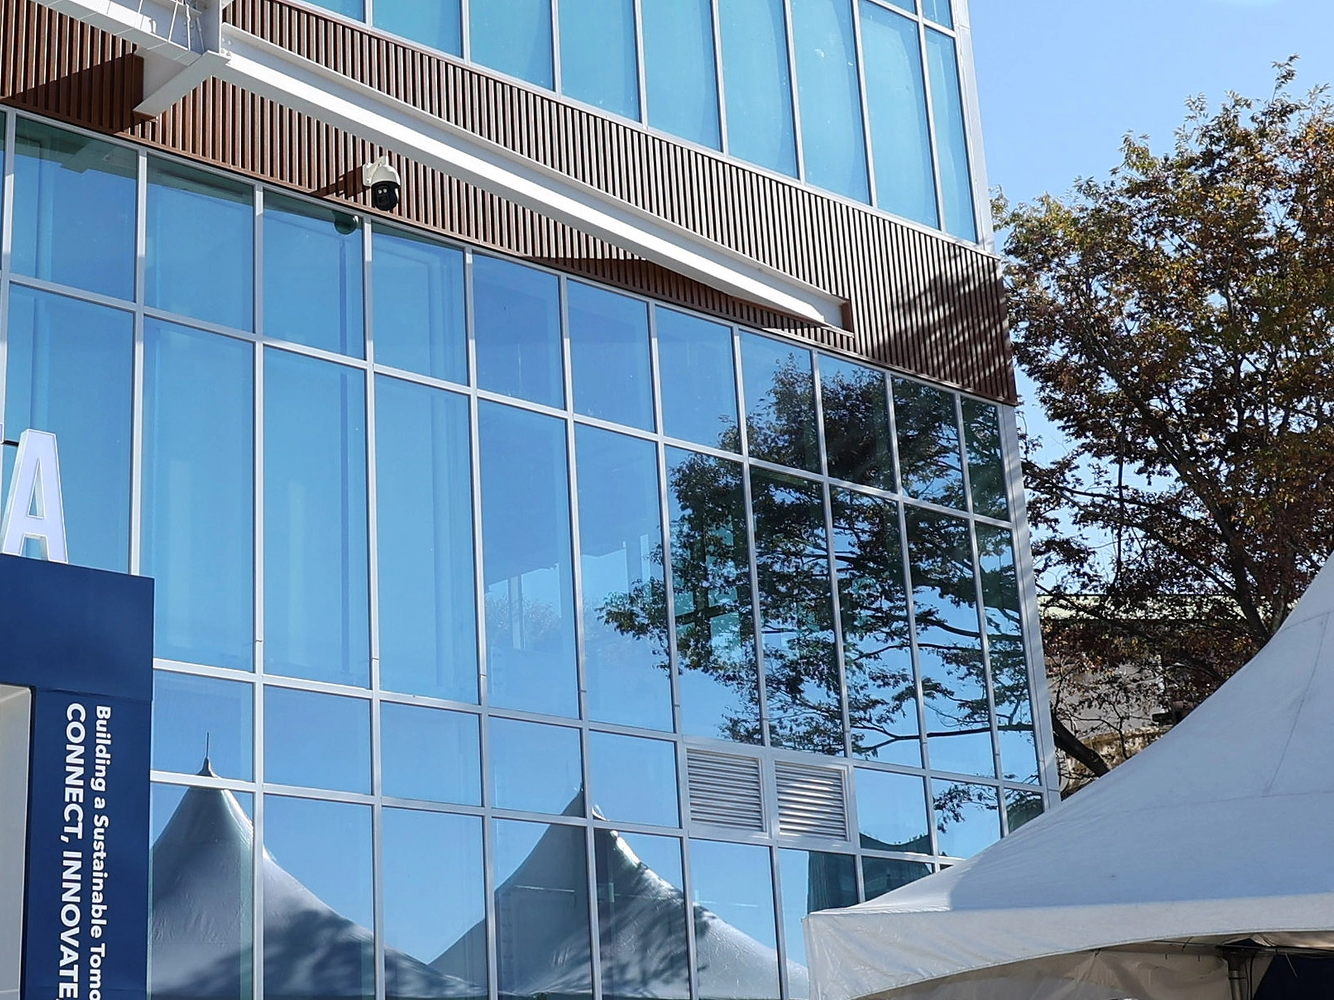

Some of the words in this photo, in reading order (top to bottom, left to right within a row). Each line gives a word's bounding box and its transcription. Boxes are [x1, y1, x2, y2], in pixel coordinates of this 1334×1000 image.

[60, 702, 86, 843] CONNECT,
[90, 704, 112, 792] Building
[94, 797, 106, 809] a
[90, 813, 110, 939] Sustainable
